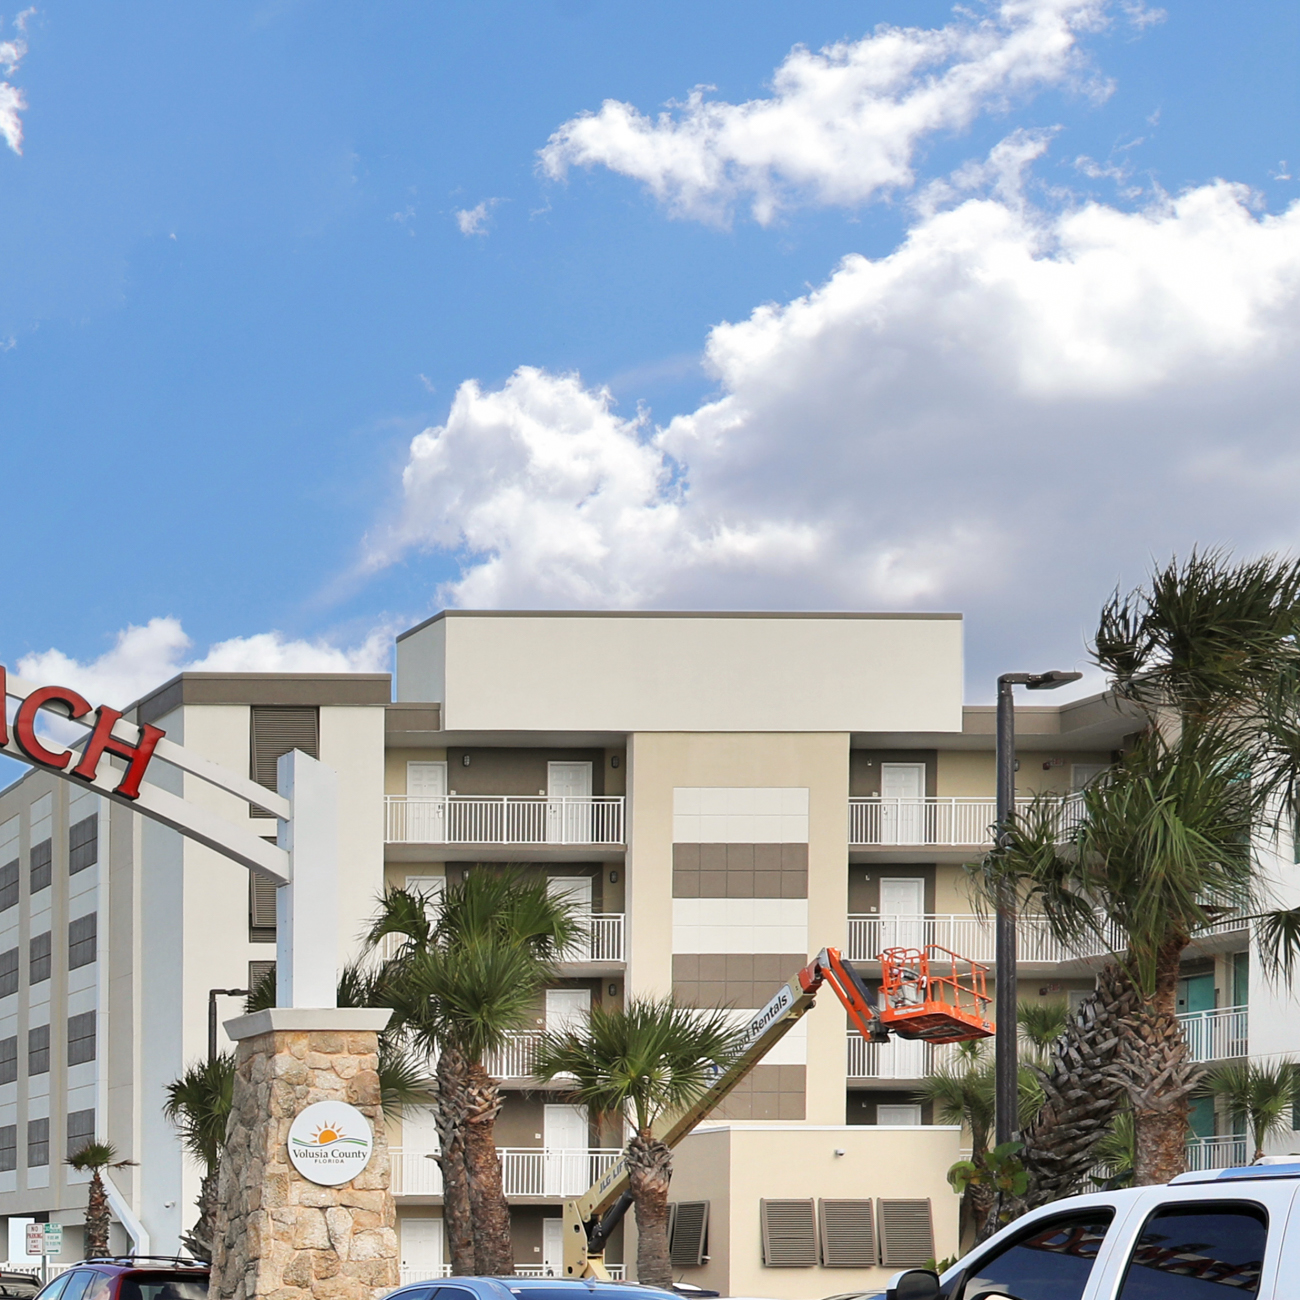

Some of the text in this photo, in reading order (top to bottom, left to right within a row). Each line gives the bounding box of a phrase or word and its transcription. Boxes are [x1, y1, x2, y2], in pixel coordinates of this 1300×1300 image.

[751, 994, 788, 1036] Rentals
[293, 1149, 367, 1161] Volusia County
